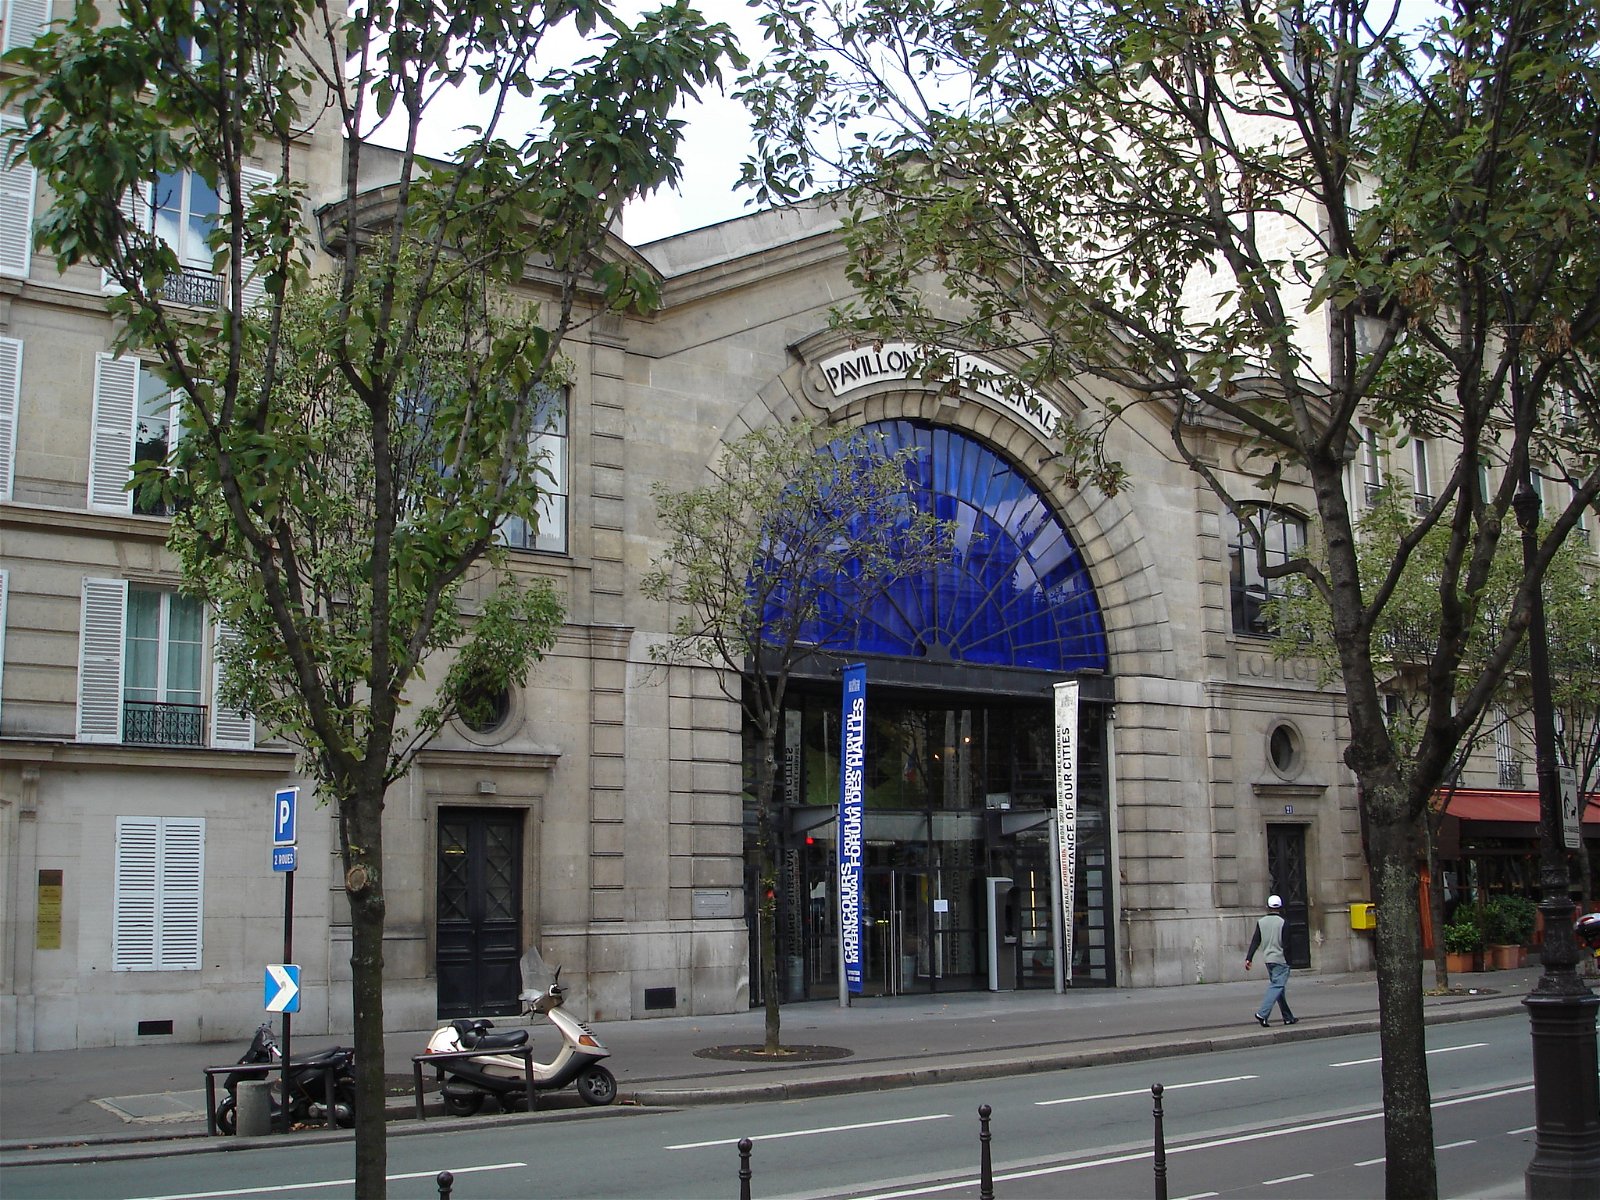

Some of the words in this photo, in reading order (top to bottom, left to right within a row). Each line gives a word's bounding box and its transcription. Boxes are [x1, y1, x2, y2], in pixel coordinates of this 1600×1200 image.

[826, 349, 924, 390] PAVILLON
[847, 713, 854, 731] DU
[852, 698, 863, 767] HALLES
[1062, 727, 1073, 770] CITIES
[845, 732, 854, 804] RENOVATION
[851, 770, 862, 802] DES
[1063, 773, 1073, 800] OUR
[279, 800, 290, 833] P
[844, 806, 852, 822] LA
[1064, 804, 1074, 820] OF
[843, 825, 852, 856] POUR
[850, 807, 862, 867] FORUM
[274, 854, 278, 865] 2
[279, 853, 293, 865] ROUES
[841, 863, 852, 963] CONCOURS
[850, 870, 859, 963] INTERNATIONAL
